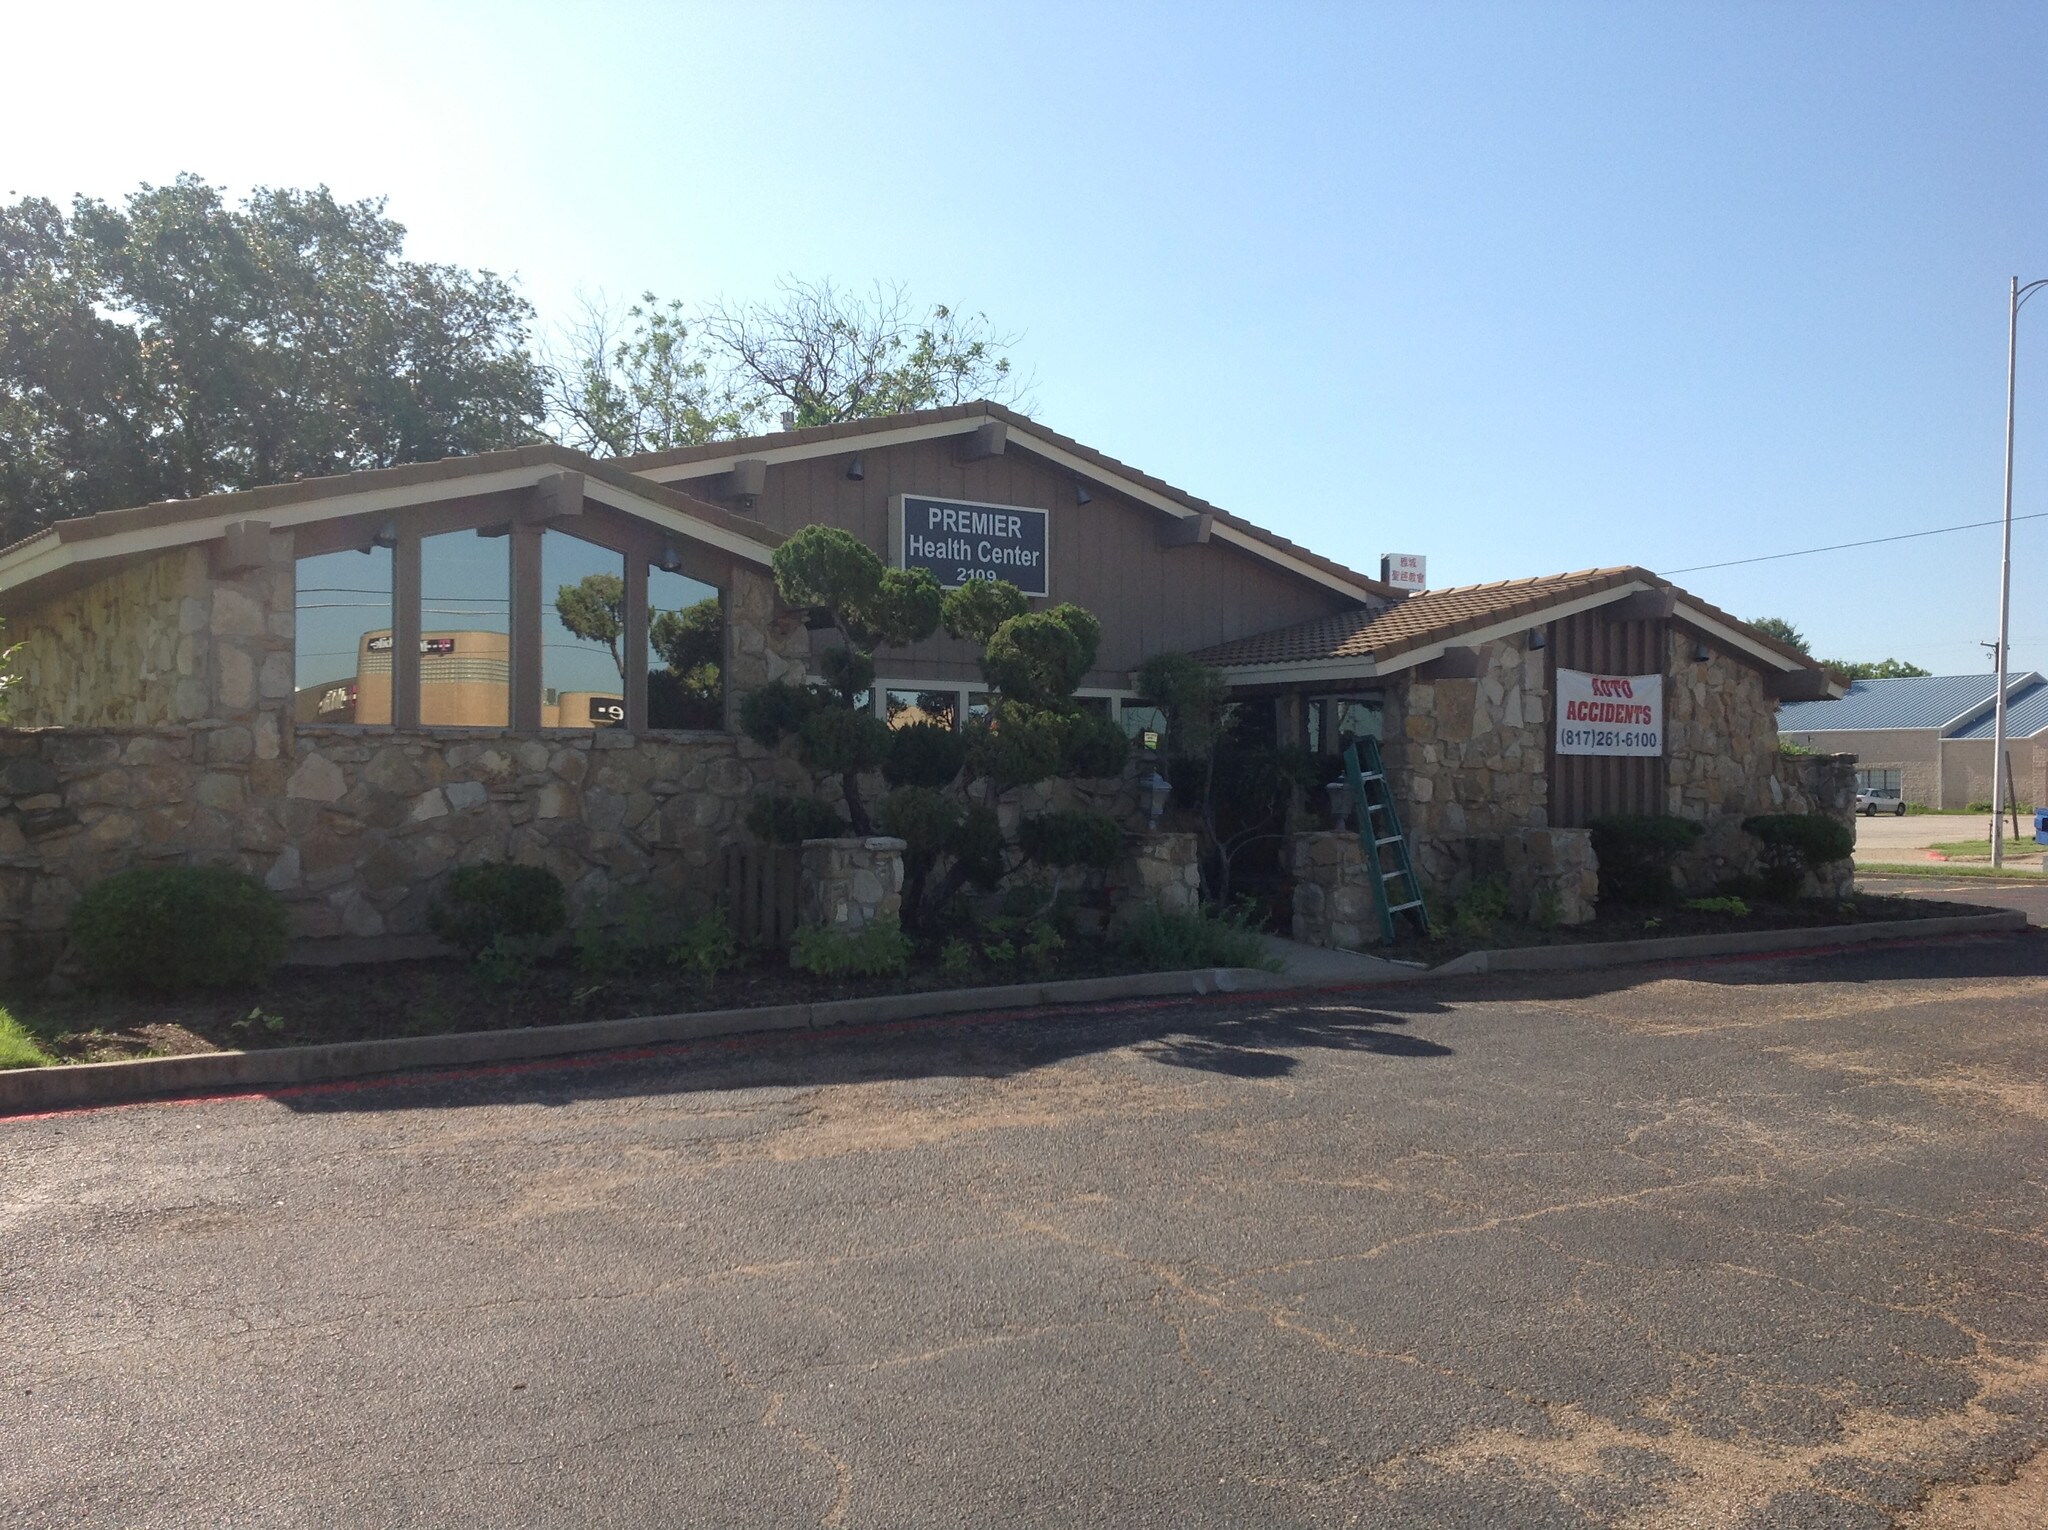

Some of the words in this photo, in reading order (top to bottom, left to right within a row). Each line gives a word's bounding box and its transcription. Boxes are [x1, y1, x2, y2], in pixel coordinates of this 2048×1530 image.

[929, 507, 1022, 539] PREMIER
[909, 534, 971, 561] Health
[978, 540, 1040, 567] Center
[956, 567, 997, 583] 2109
[1591, 678, 1634, 699] AUTO
[1566, 700, 1652, 725] ACCIDENTS
[1561, 728, 1657, 748] (817)261-6100
